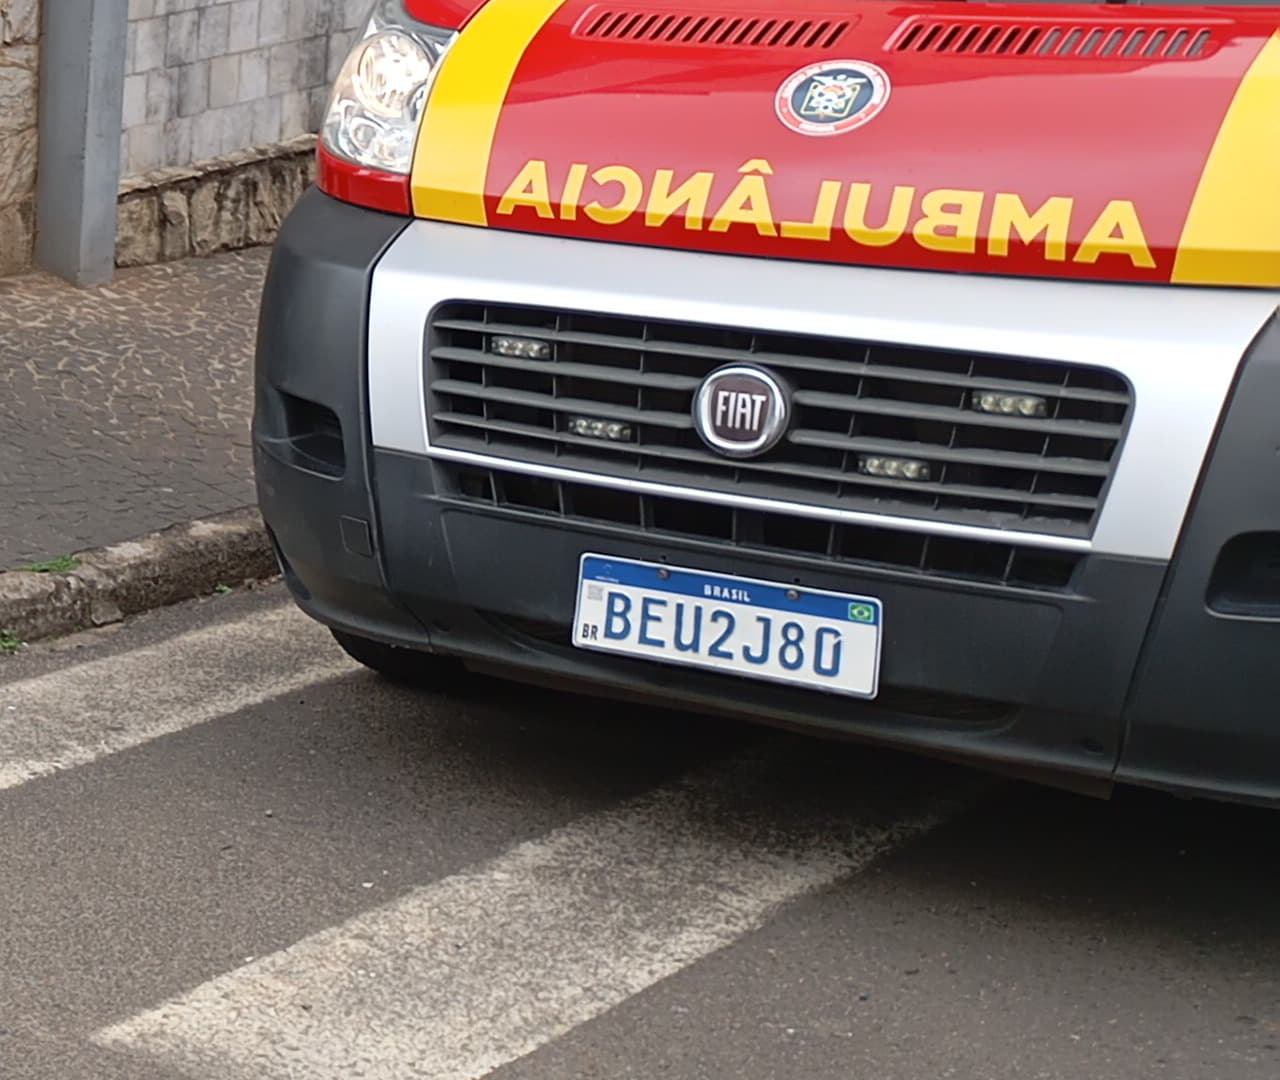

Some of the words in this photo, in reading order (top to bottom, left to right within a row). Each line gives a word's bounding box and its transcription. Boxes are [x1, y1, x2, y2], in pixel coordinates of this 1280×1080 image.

[716, 390, 767, 431] FIAT
[704, 583, 751, 602] BRASIL
[582, 623, 598, 641] BR
[603, 591, 842, 677] BEU2J80
